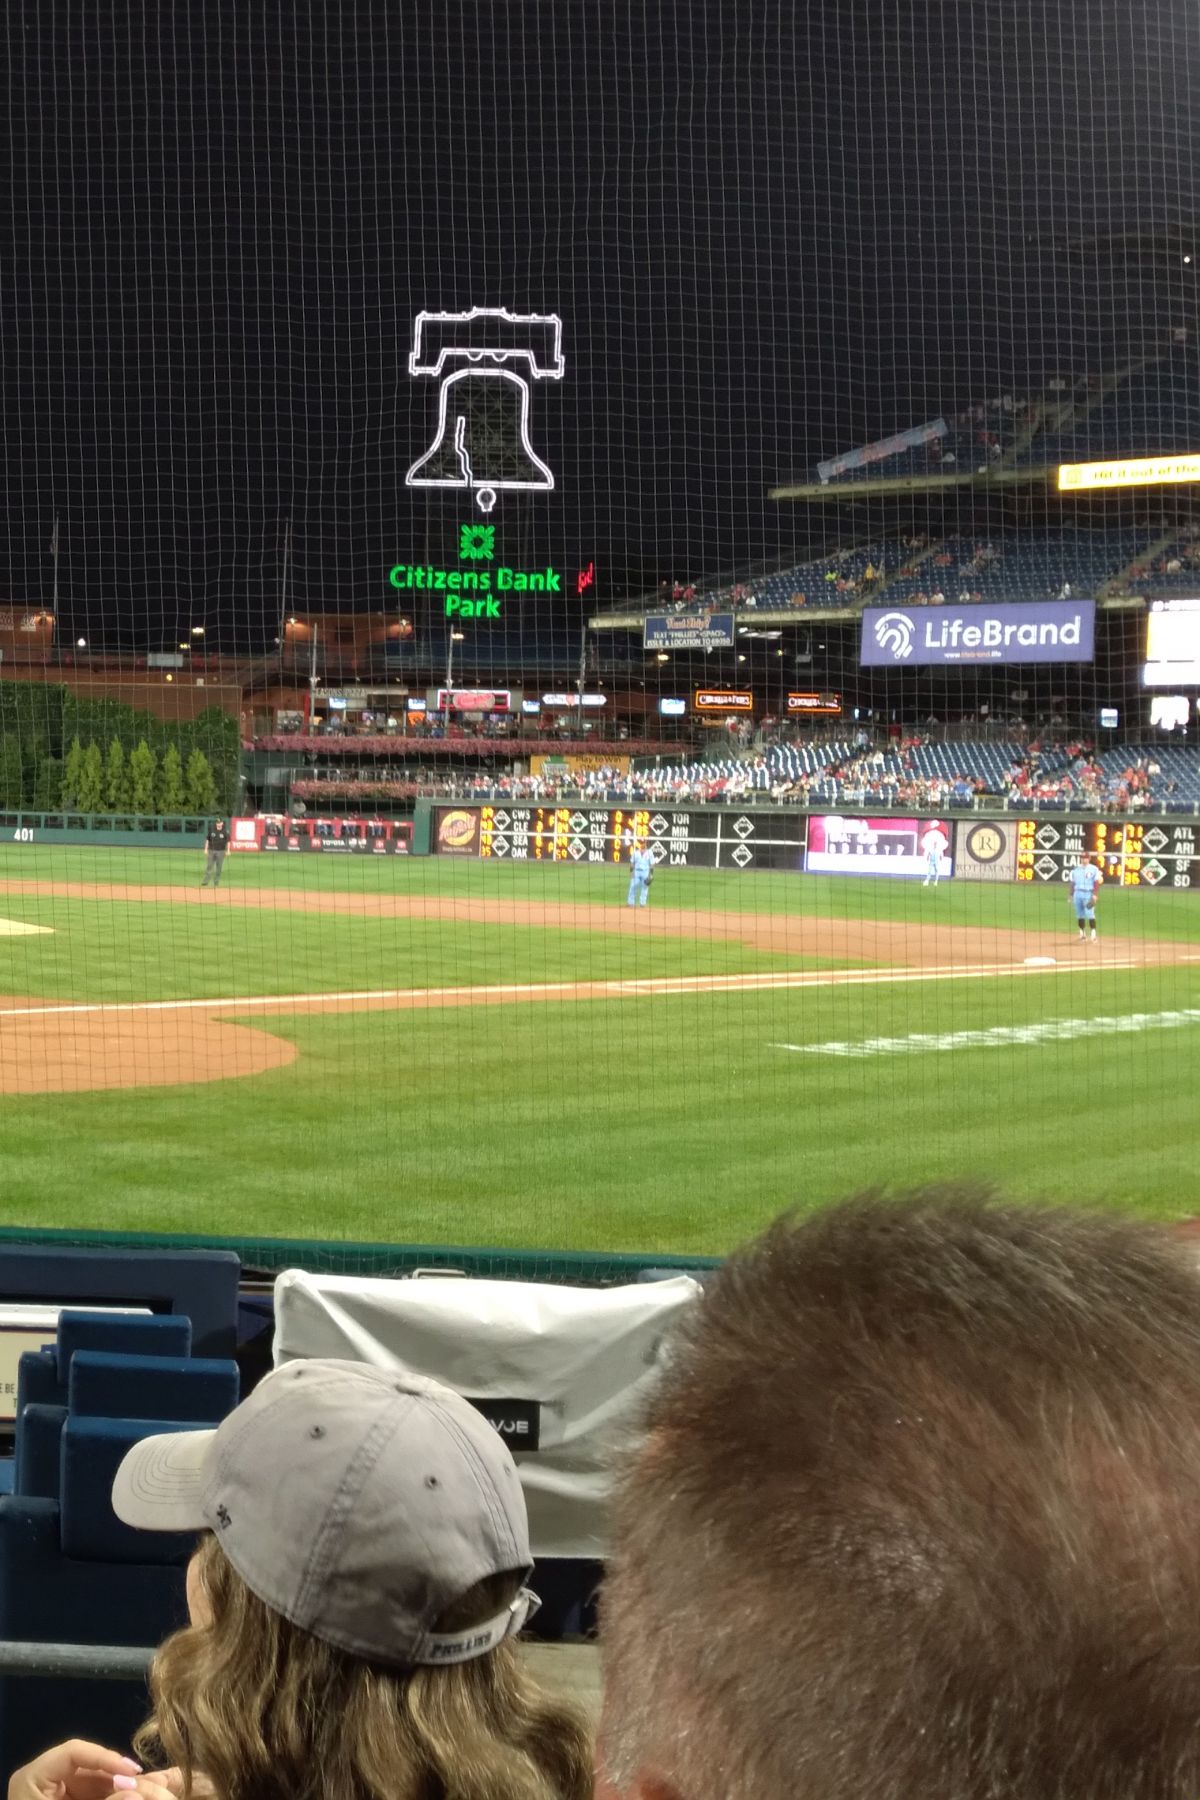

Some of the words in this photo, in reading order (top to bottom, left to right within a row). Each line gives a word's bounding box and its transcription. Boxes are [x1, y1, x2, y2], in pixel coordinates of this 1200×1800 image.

[389, 564, 490, 590] Citizens
[497, 567, 561, 592] Bank
[445, 594, 501, 618] Park
[925, 615, 1082, 648] LifeBrand
[512, 809, 530, 820] CWS
[589, 810, 608, 822] CWS
[672, 813, 689, 824] TOR
[513, 821, 529, 832] CLE
[591, 823, 606, 834] CLE
[672, 826, 688, 837] MIN
[1065, 824, 1085, 836] STL
[14, 828, 34, 841] 401
[1174, 827, 1195, 840] ATL
[512, 835, 528, 846] SEA
[590, 837, 605, 848] TEX
[670, 841, 689, 852] HOU
[1065, 839, 1084, 851] MIL
[511, 847, 527, 859] OAK
[1174, 842, 1195, 855] ARI
[589, 850, 604, 862] BAL
[670, 854, 687, 865] LAA
[1176, 860, 1190, 872] SF
[1174, 874, 1190, 887] SD
[4, 1383, 15, 1394] BE
